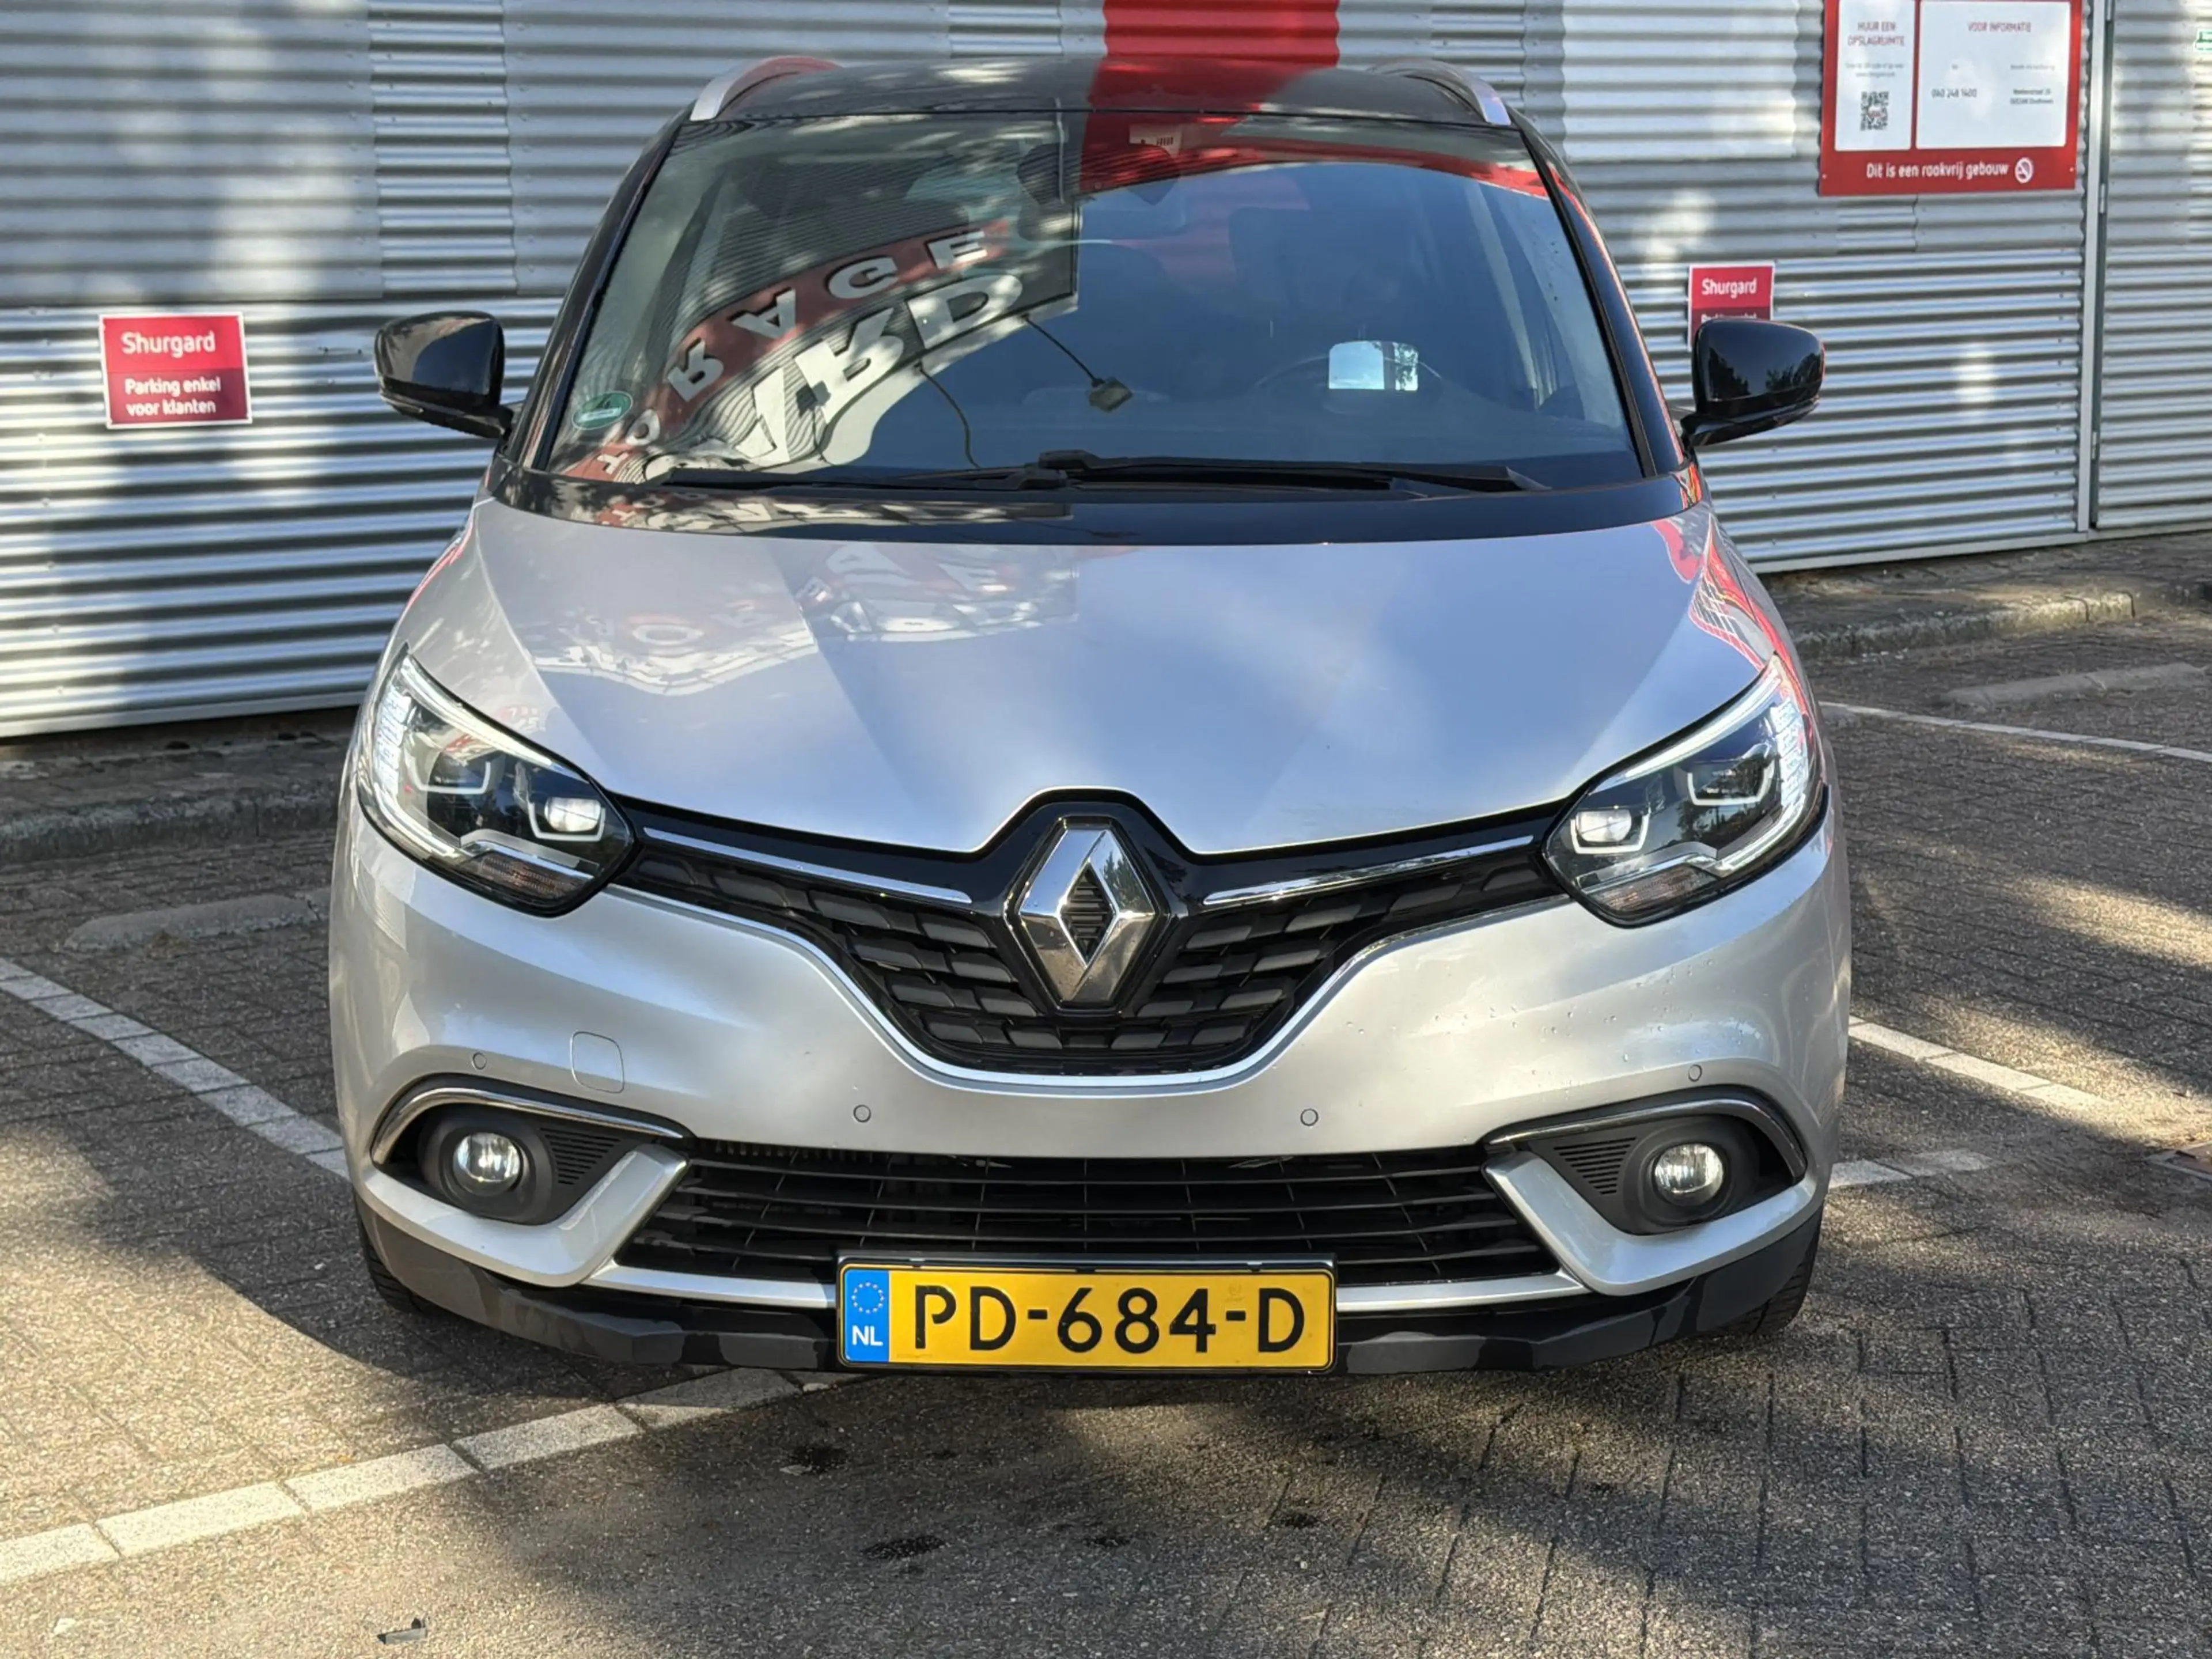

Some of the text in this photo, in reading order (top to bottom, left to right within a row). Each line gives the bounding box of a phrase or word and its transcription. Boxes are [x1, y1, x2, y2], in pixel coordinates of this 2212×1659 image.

[1967, 22, 2031, 32] VOOR INFORMATIE
[1866, 160, 2009, 180] Dit is een rookvrij gebouw
[1701, 277, 1758, 298] Shurgard
[120, 330, 216, 358] Shurgard
[124, 376, 221, 397] Parking enkel
[126, 399, 217, 417] voor klanten
[914, 1285, 1305, 1354] PD-684-D
[851, 1324, 883, 1348] NL
